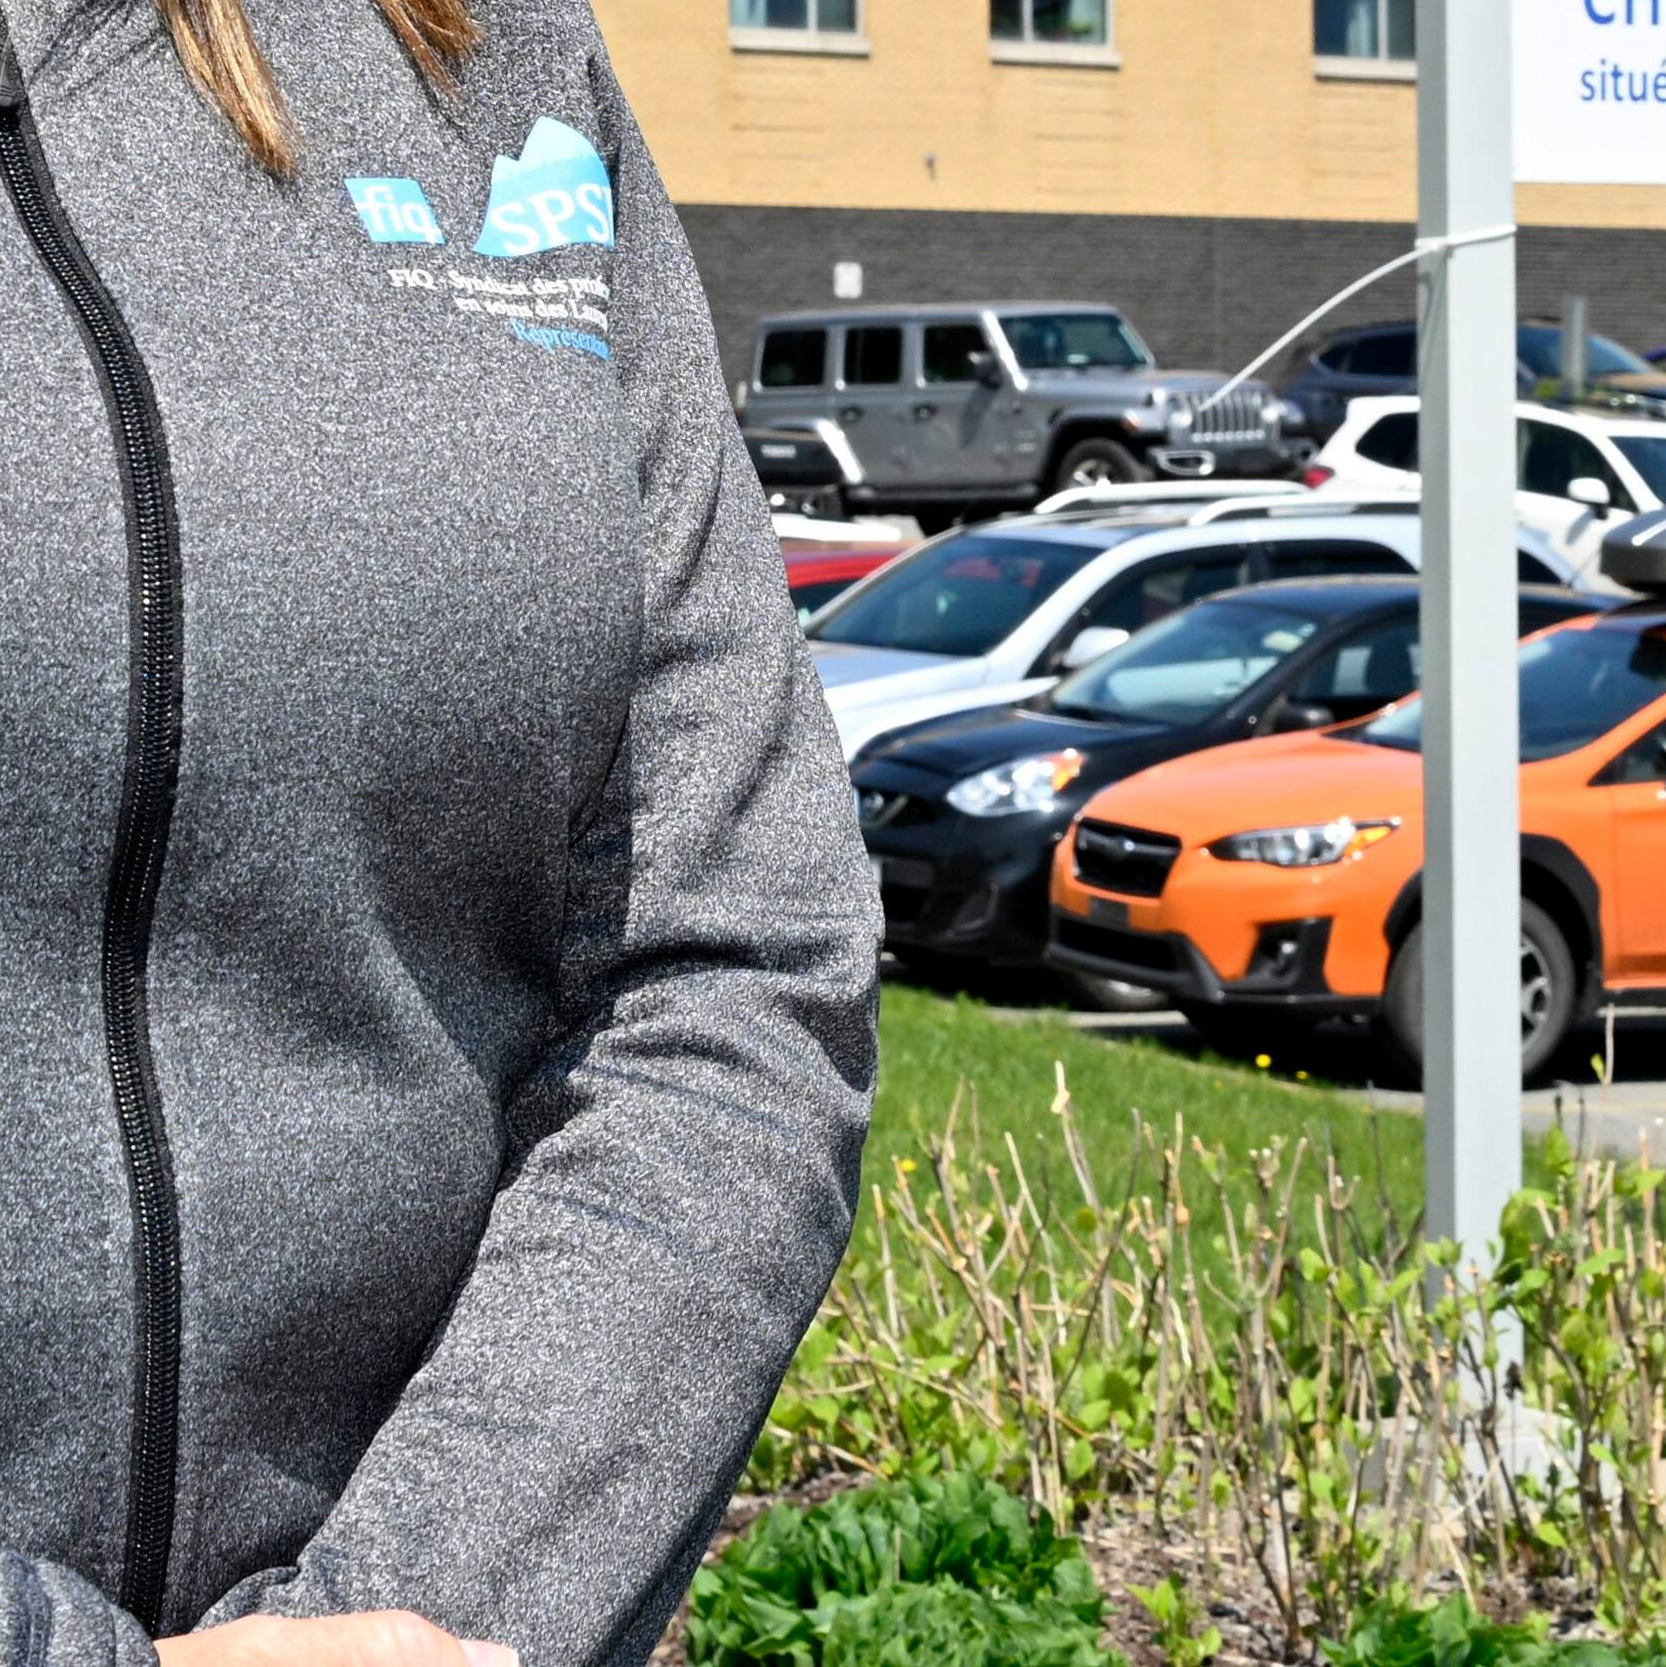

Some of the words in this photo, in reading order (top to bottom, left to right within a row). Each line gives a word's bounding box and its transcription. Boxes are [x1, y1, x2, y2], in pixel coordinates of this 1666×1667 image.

[355, 185, 442, 244] fiq
[387, 269, 438, 290] FIQ
[447, 270, 532, 296] Syndicat
[532, 278, 569, 295] des
[453, 295, 485, 312] en
[534, 298, 569, 319] des
